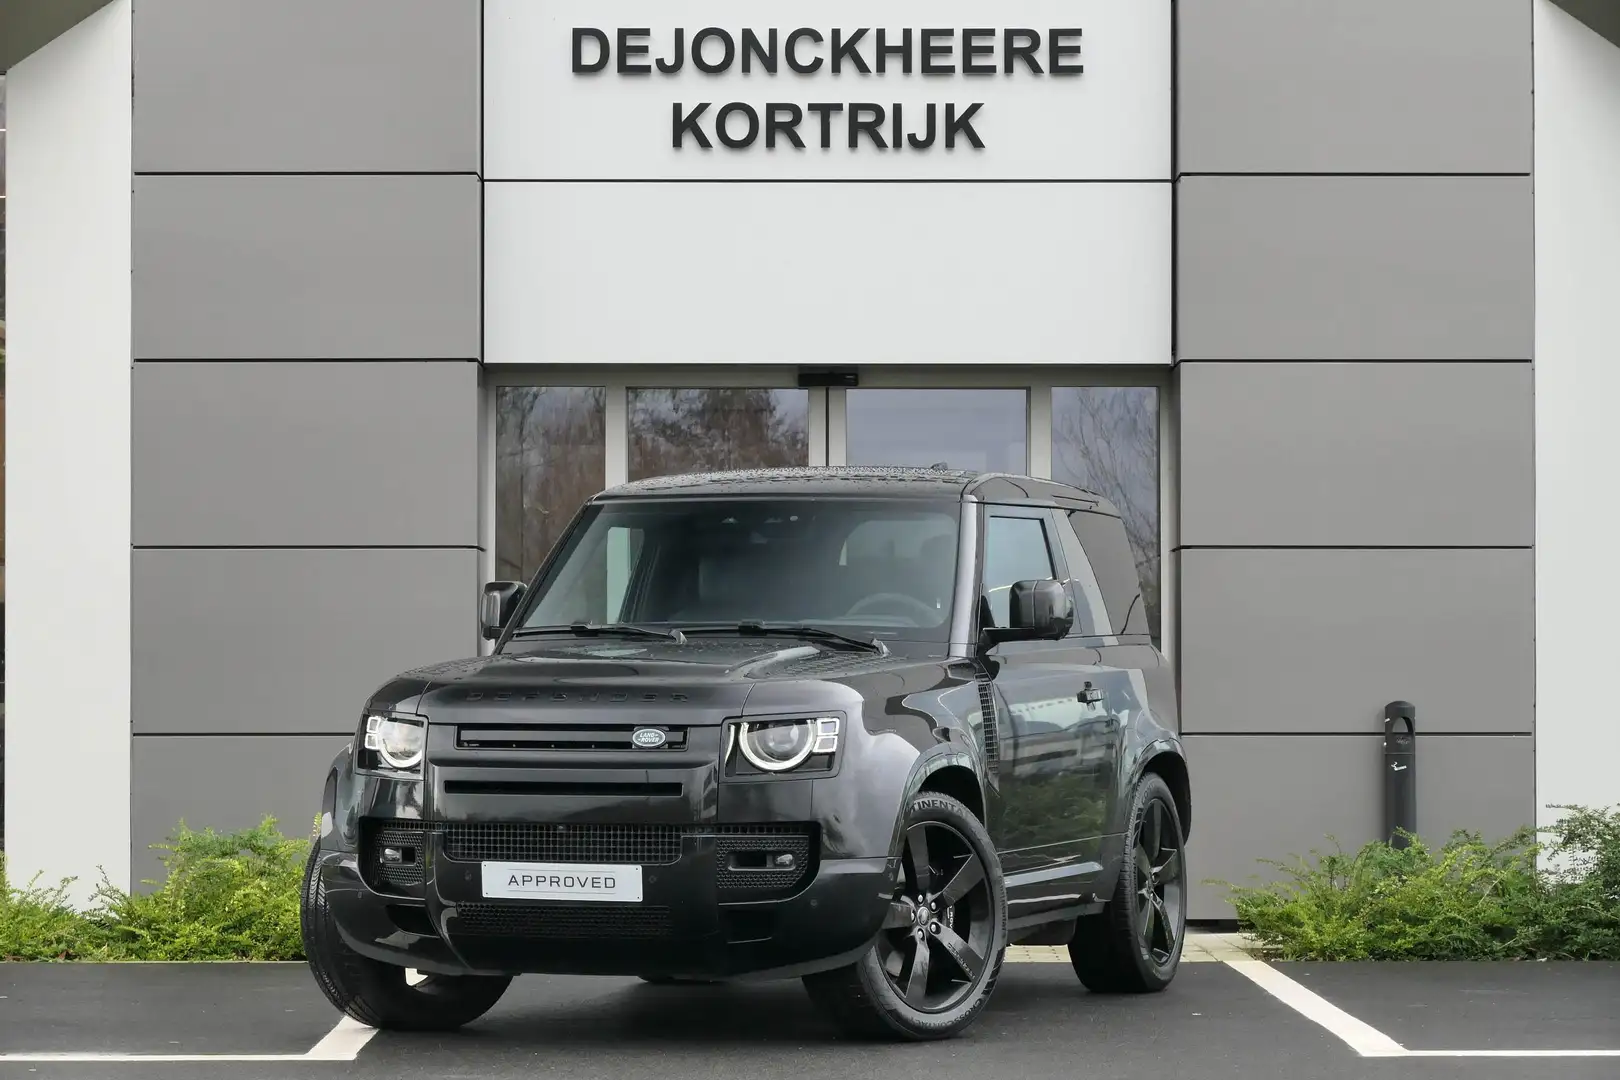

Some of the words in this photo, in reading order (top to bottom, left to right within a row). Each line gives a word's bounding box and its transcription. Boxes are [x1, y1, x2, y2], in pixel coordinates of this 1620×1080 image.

[571, 27, 1084, 75] DEJONCKHEERE
[672, 102, 986, 149] KORTRIJK
[508, 874, 616, 889] APPROVED
